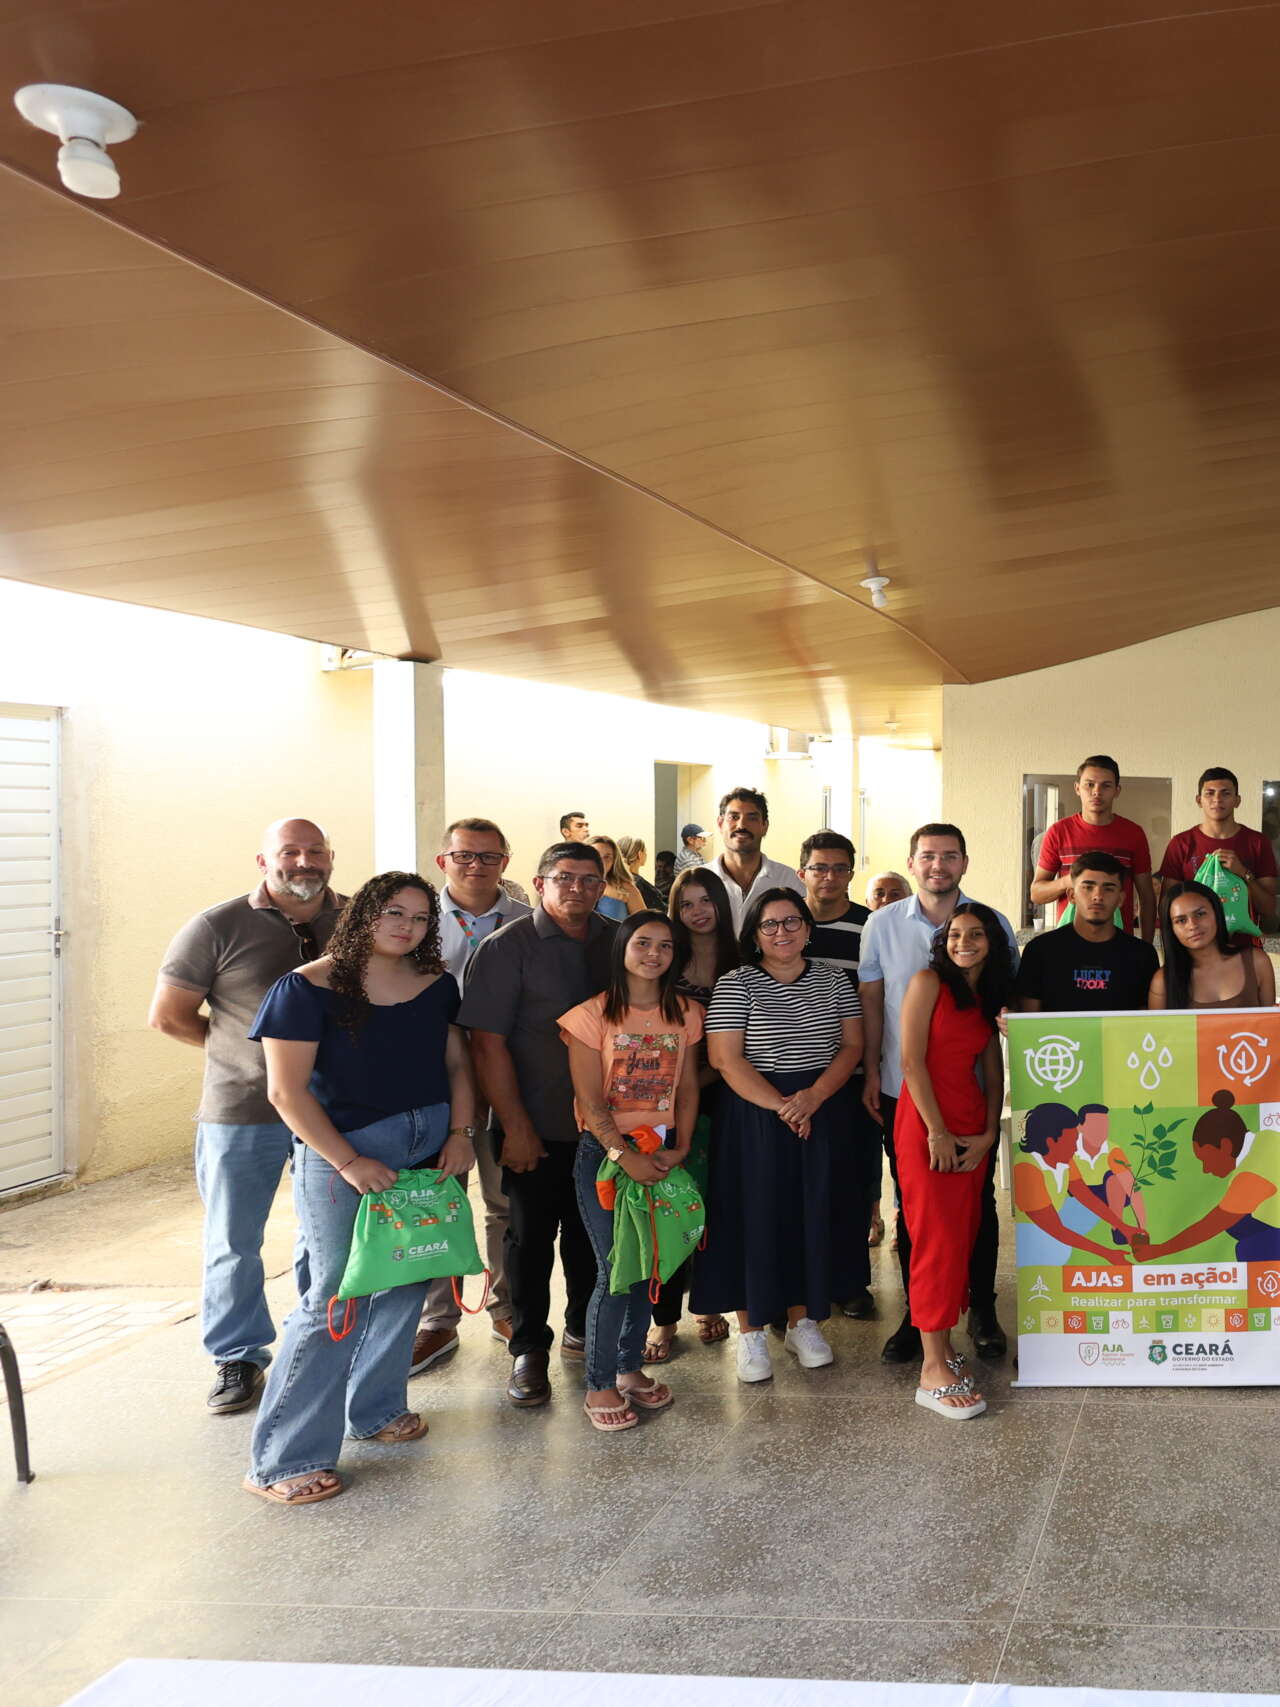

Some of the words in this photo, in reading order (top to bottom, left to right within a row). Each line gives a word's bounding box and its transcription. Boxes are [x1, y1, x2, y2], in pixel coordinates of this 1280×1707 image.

[1073, 969, 1111, 981] LUCKY
[410, 1189, 435, 1197] AJA
[408, 1240, 448, 1255] CEARÁ
[1071, 1271, 1124, 1287] AJAs
[1143, 1273, 1176, 1286] em
[1180, 1267, 1238, 1289] ação!
[1071, 1296, 1122, 1307] Realizar
[1127, 1299, 1156, 1309] para
[1101, 1344, 1125, 1353] AJA
[1172, 1339, 1233, 1356] CEARÁ
